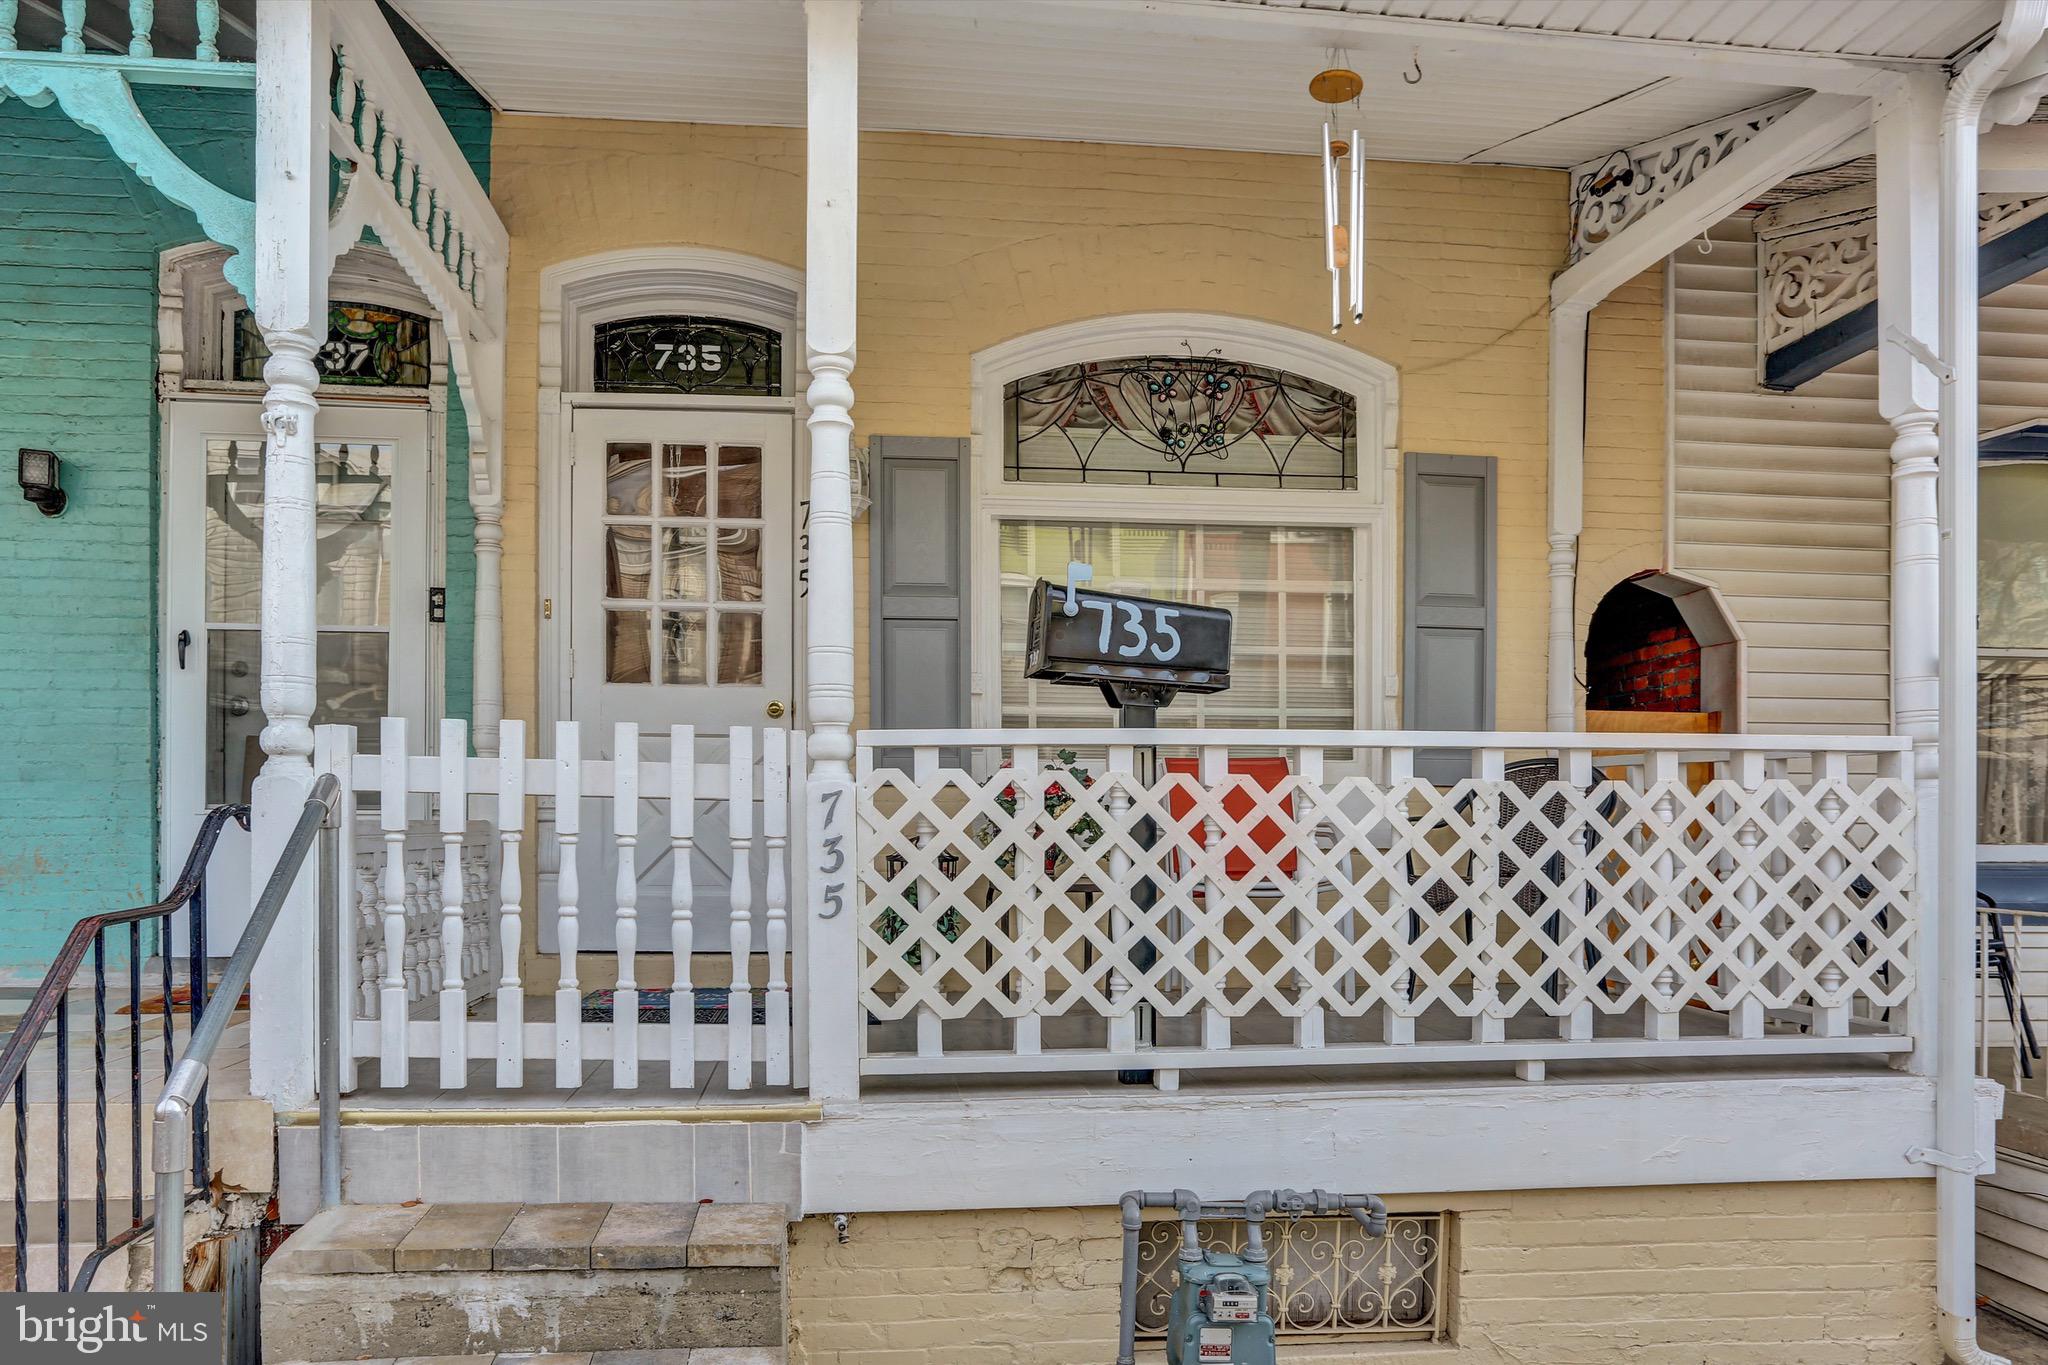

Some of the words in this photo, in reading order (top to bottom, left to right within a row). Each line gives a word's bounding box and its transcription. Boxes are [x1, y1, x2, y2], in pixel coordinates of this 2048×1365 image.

[324, 341, 369, 371] 37
[654, 343, 722, 372] 735
[1081, 600, 1182, 662] 735
[818, 789, 845, 919] 735
